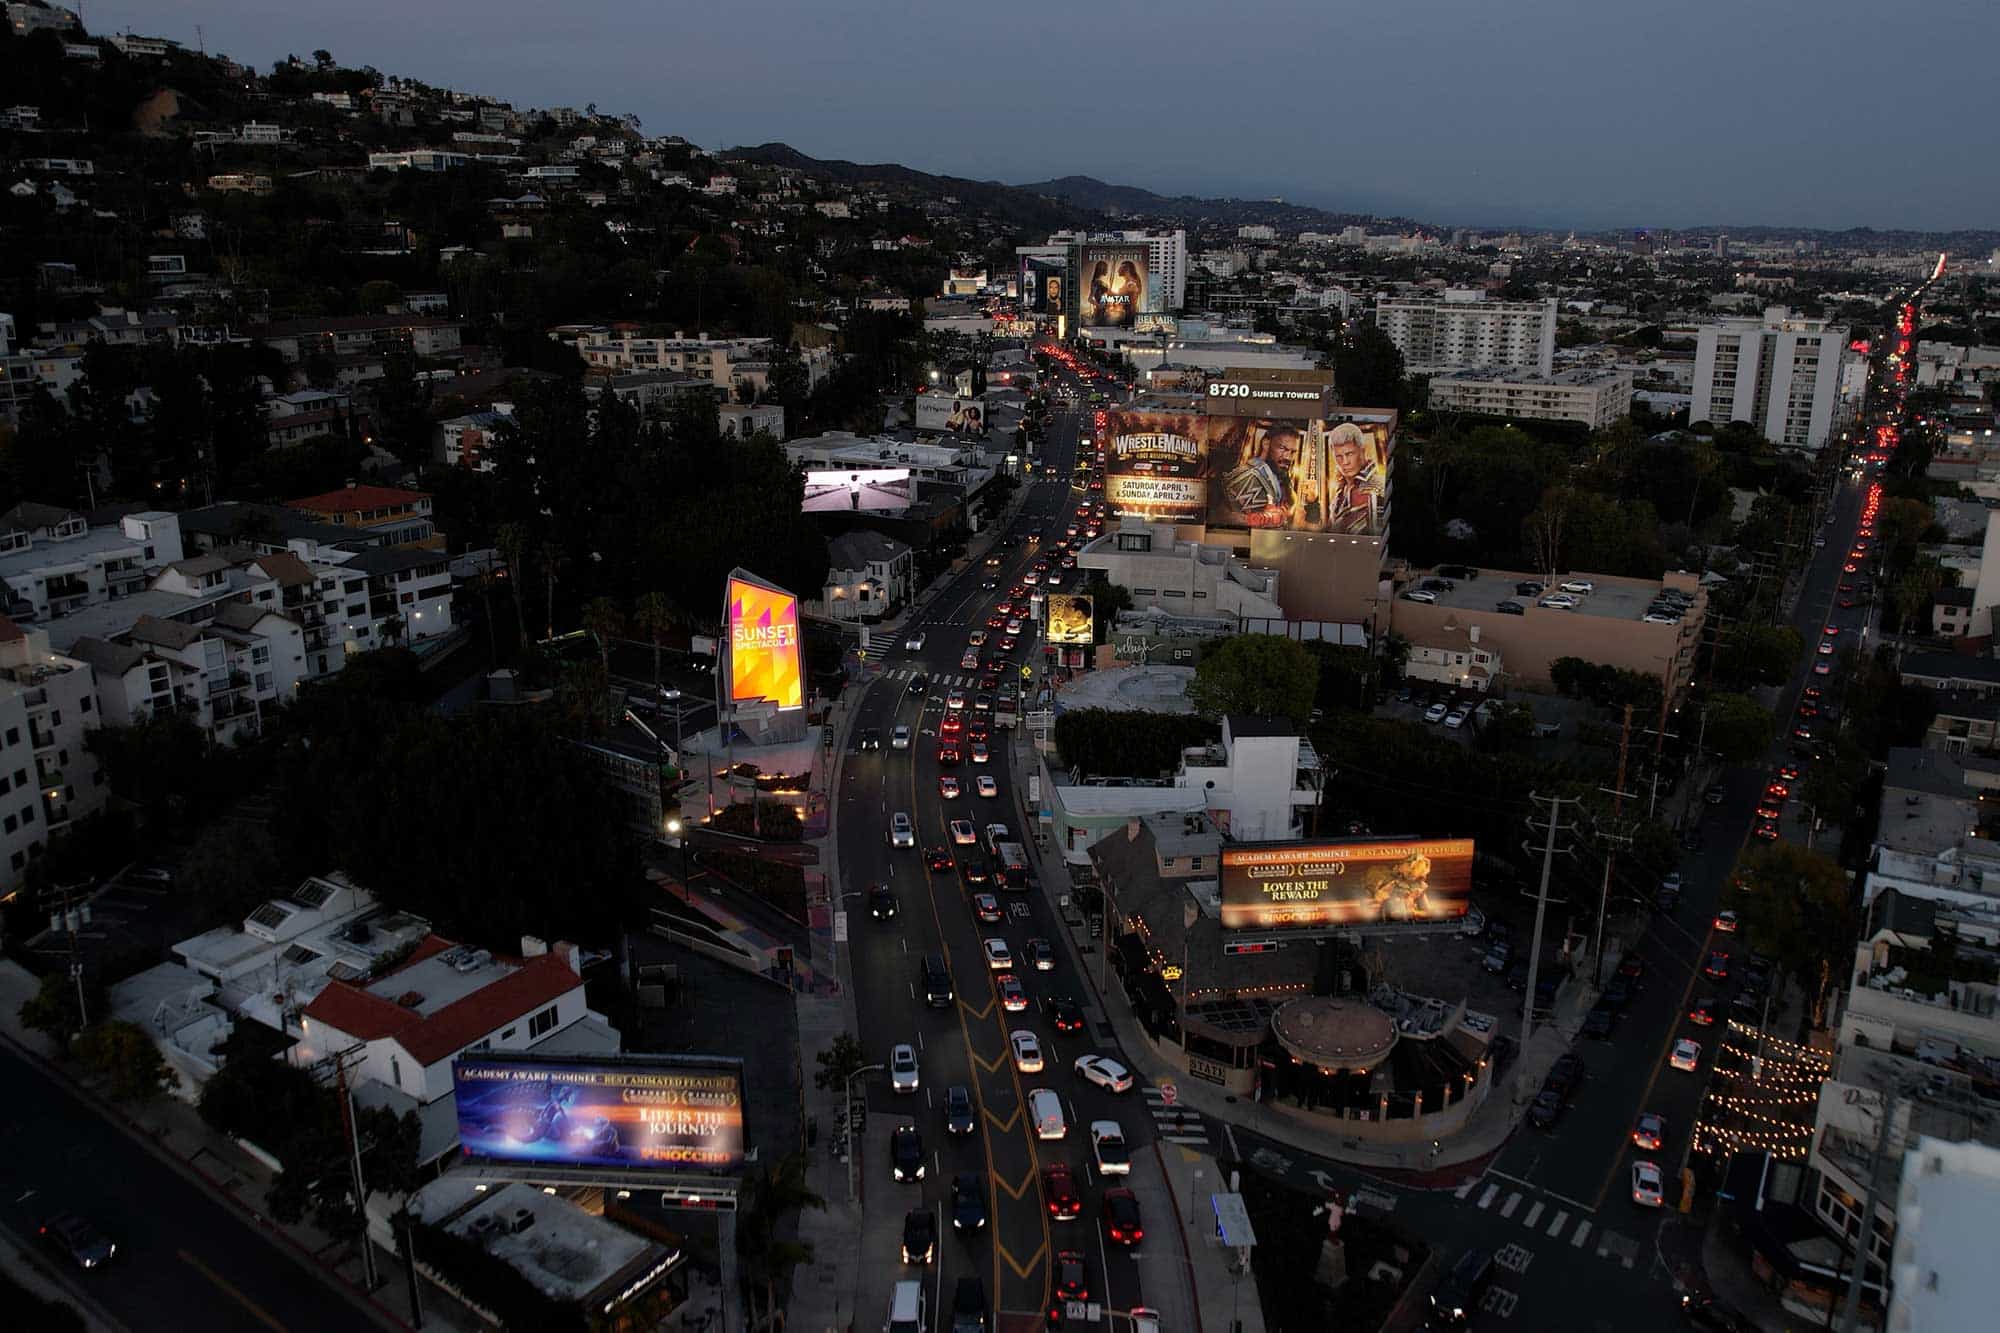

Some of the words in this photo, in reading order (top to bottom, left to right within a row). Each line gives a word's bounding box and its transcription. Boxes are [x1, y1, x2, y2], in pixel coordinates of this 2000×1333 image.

[1100, 294, 1131, 304] AVATAR
[1209, 384, 1250, 398] 8730
[1252, 391, 1284, 399] SUNSET
[1285, 391, 1320, 400] TOWERS
[1122, 481, 1160, 491] SATURDAY,
[1162, 483, 1183, 492] APRIL
[1152, 491, 1174, 500] APRIL
[734, 624, 794, 641] SUNSET
[1280, 852, 1310, 860] AWARD
[1312, 850, 1351, 859] NOMINEE
[1263, 882, 1293, 893] LOVE
[1294, 881, 1305, 891] IS
[1306, 880, 1328, 891] THE
[1272, 890, 1319, 901] REWARD
[464, 1069, 511, 1080] ACADEMY
[512, 1070, 549, 1081] AWARD
[551, 1072, 595, 1083] NOMINEE
[640, 1108, 671, 1122] LIFE
[673, 1110, 690, 1123] IS
[694, 1111, 724, 1124] THE
[650, 1121, 720, 1137] JOURNEY
